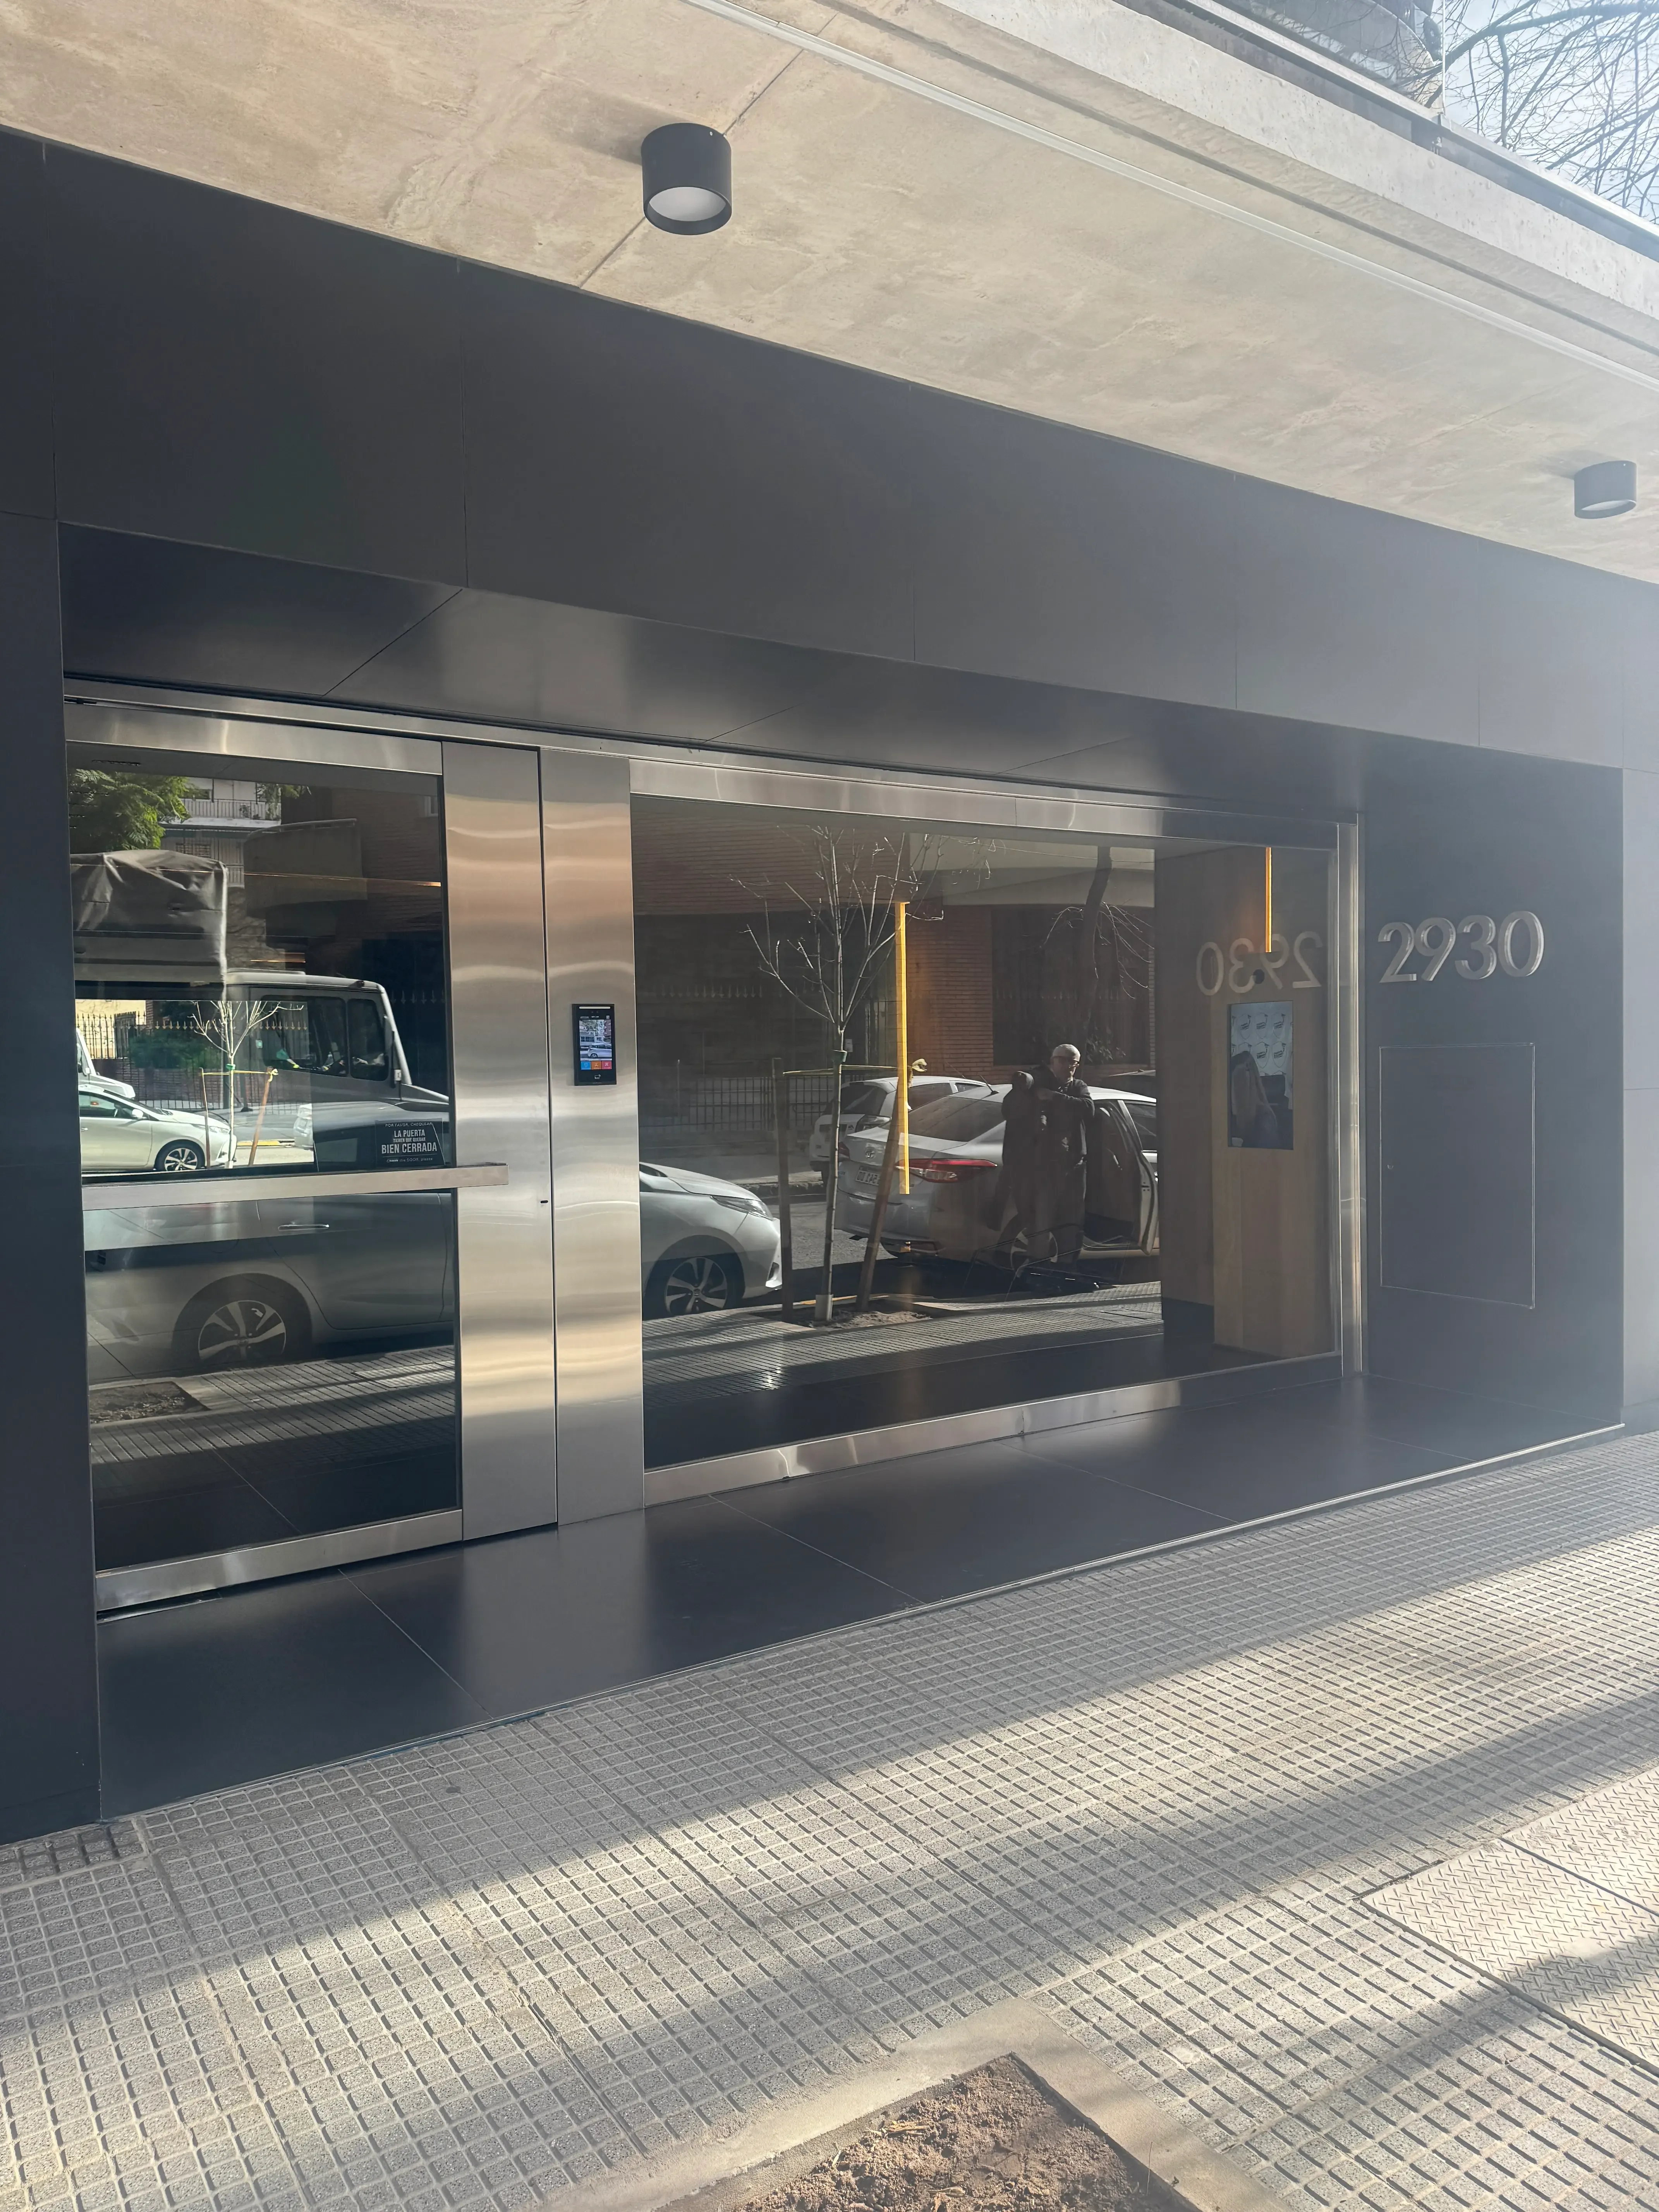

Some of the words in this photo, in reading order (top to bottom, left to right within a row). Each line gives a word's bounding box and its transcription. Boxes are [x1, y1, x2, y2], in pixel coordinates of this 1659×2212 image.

[1378, 911, 1544, 983] 2930
[403, 1129, 425, 1137] PUERTA
[381, 1144, 399, 1154] BIEN
[402, 1142, 437, 1153] CERRADA
